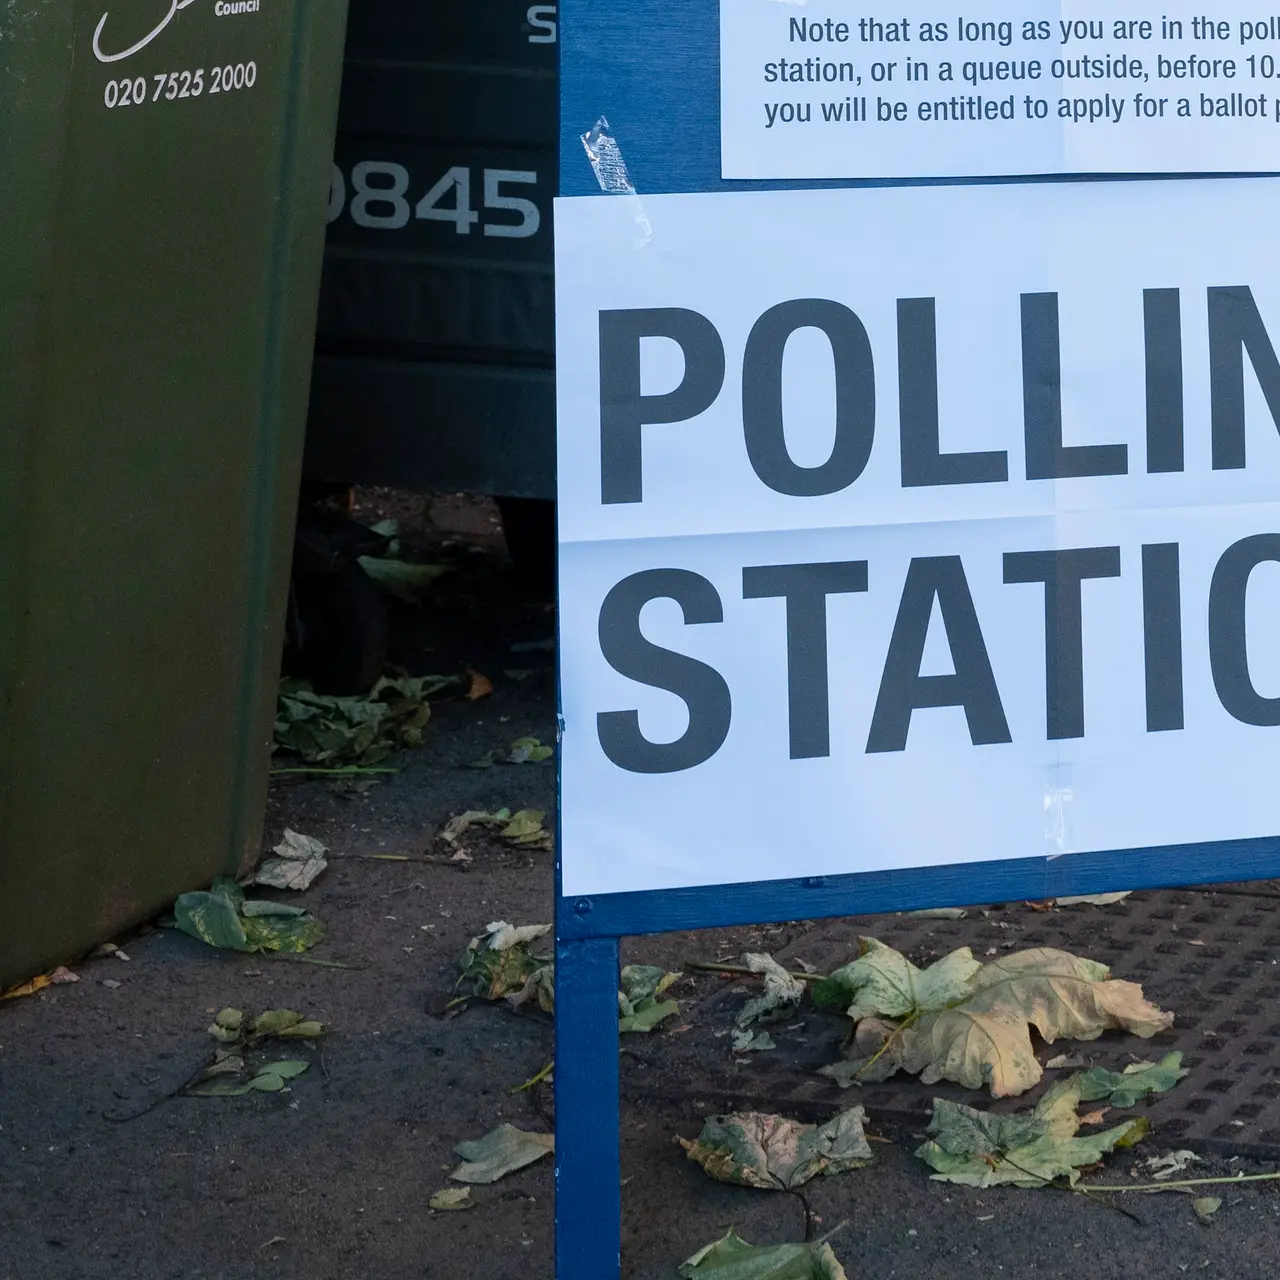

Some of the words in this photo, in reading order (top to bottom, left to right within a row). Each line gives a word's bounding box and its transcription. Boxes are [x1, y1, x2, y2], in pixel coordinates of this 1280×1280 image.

[789, 17, 850, 43] Note
[857, 17, 911, 43] that
[918, 22, 949, 43] as
[958, 16, 1013, 48] long
[1021, 21, 1051, 42] as
[1058, 20, 1104, 47] you
[1113, 20, 1153, 41] are
[1161, 15, 1184, 41] in
[1190, 15, 1230, 41] the
[104, 77, 147, 108] 020
[152, 68, 204, 102] 7525
[209, 60, 257, 94] 2000
[763, 56, 862, 88] station,
[869, 61, 898, 83] or
[905, 56, 929, 82] in
[937, 61, 954, 82] a
[961, 60, 1042, 88] queue
[1050, 54, 1149, 84] outside,
[1156, 53, 1236, 79] before
[763, 102, 812, 129] you
[820, 96, 867, 123] will
[877, 96, 908, 122] be
[916, 94, 1016, 123] entitled
[1023, 95, 1049, 120] to
[1056, 93, 1125, 125] apply
[1133, 92, 1169, 118] for
[1176, 98, 1192, 118] a
[1199, 92, 1268, 118] ballot
